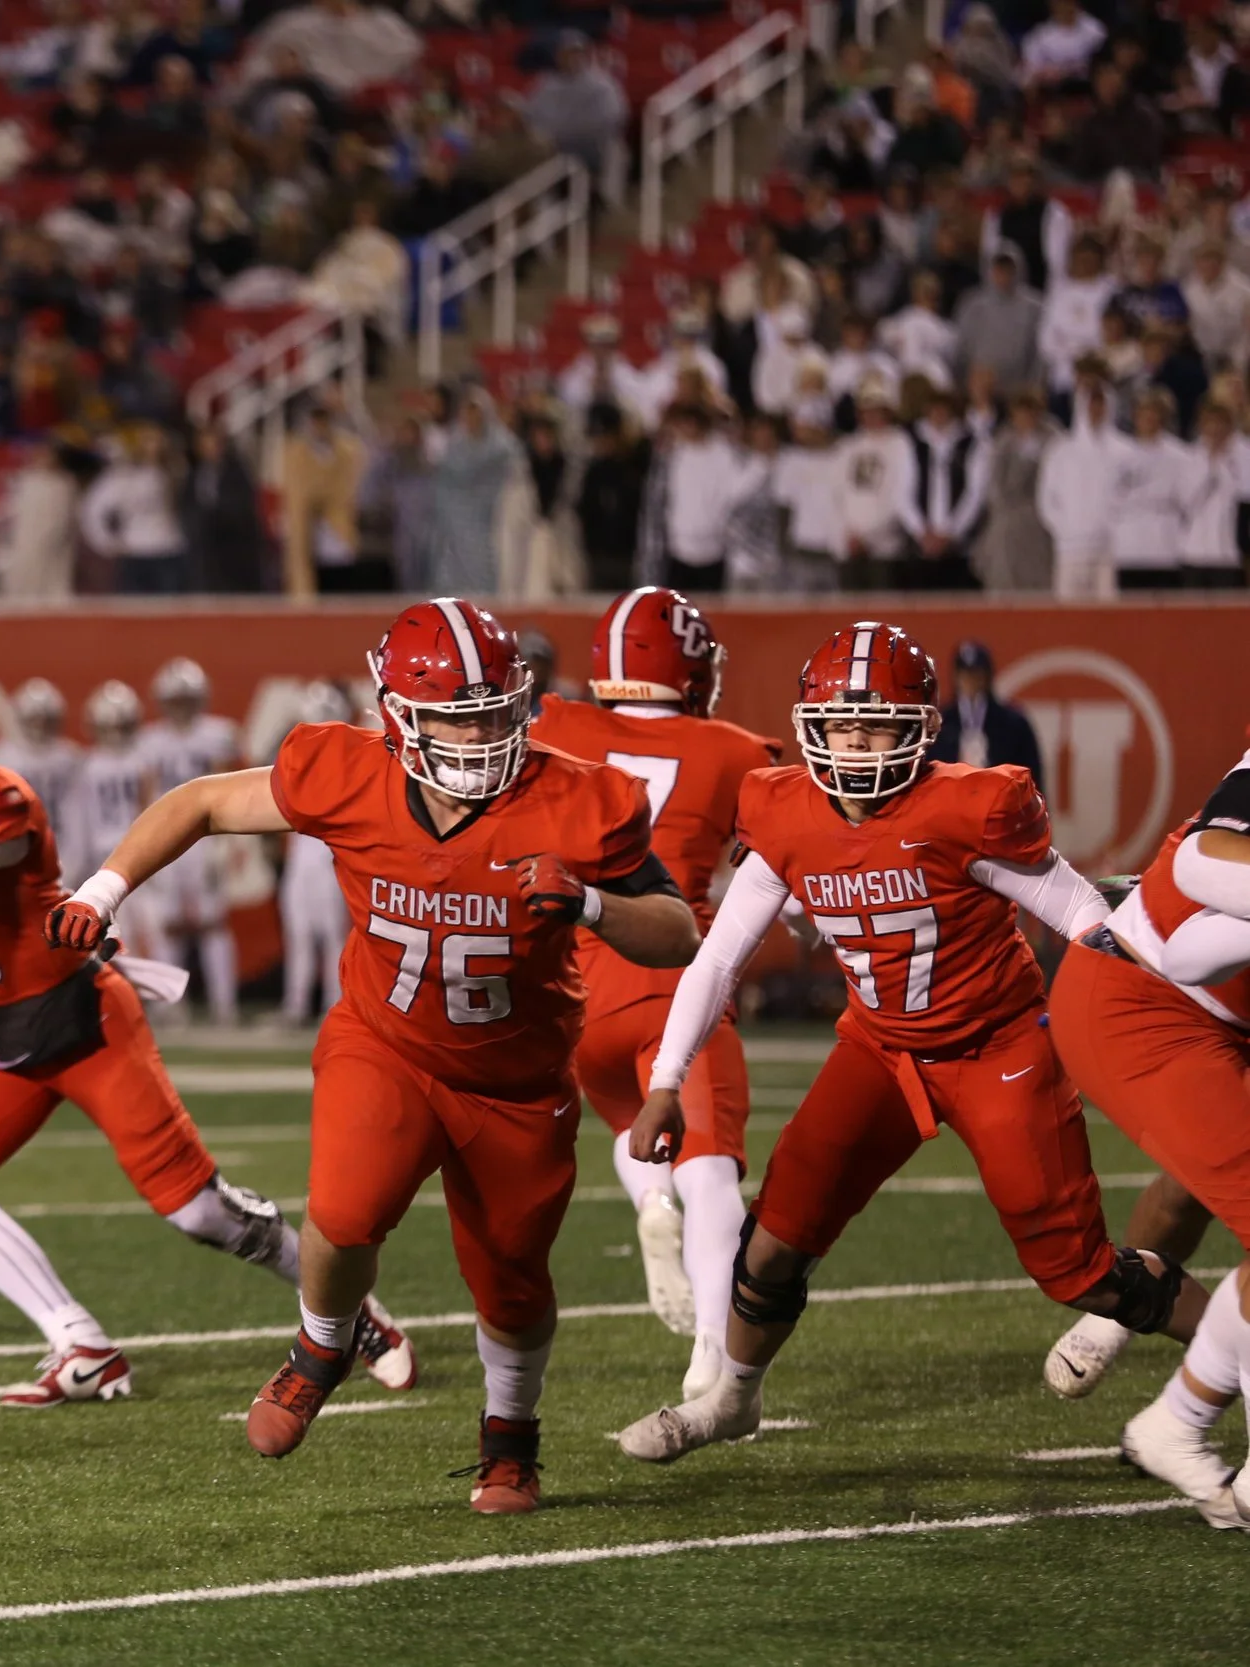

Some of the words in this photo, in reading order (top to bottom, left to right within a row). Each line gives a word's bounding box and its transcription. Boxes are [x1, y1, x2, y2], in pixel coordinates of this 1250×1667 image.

[605, 749, 681, 829] 7
[370, 876, 508, 928] CRIMSON
[803, 866, 929, 909] CRIMSON
[368, 911, 512, 1025] 76
[811, 904, 939, 1014] 57
